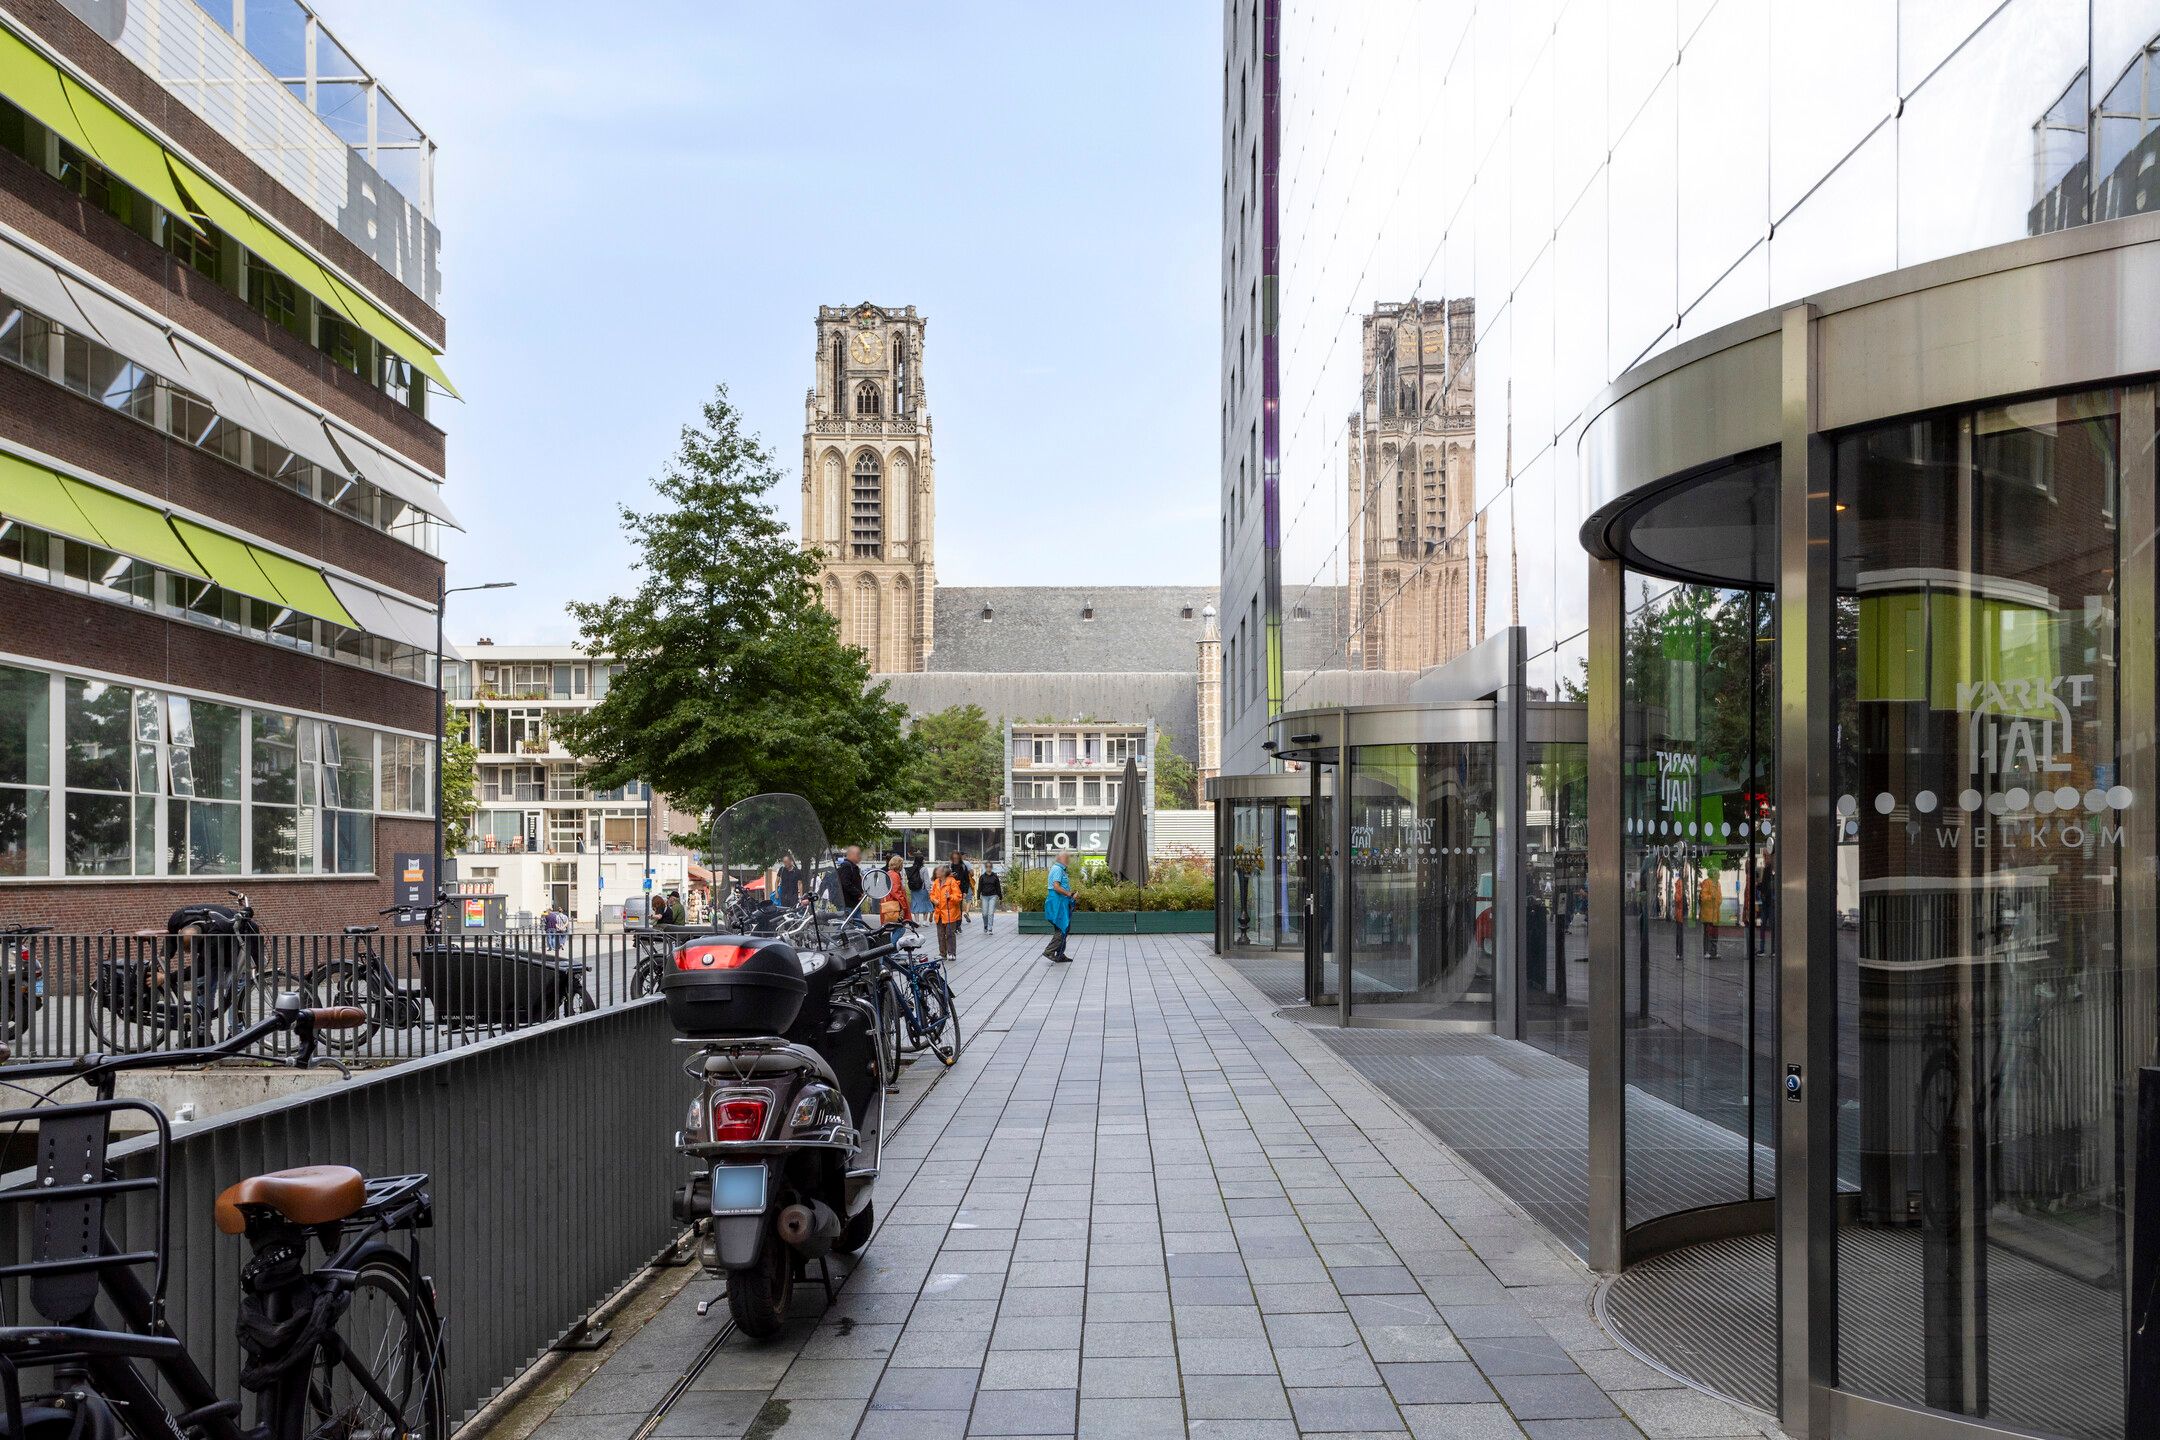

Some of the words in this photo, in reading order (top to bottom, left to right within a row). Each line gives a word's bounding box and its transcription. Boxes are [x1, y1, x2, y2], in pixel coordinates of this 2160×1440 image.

[1956, 674, 2094, 713] MARKT
[1969, 714, 2072, 774] HAL
[1936, 826, 2126, 848] WELKOM
